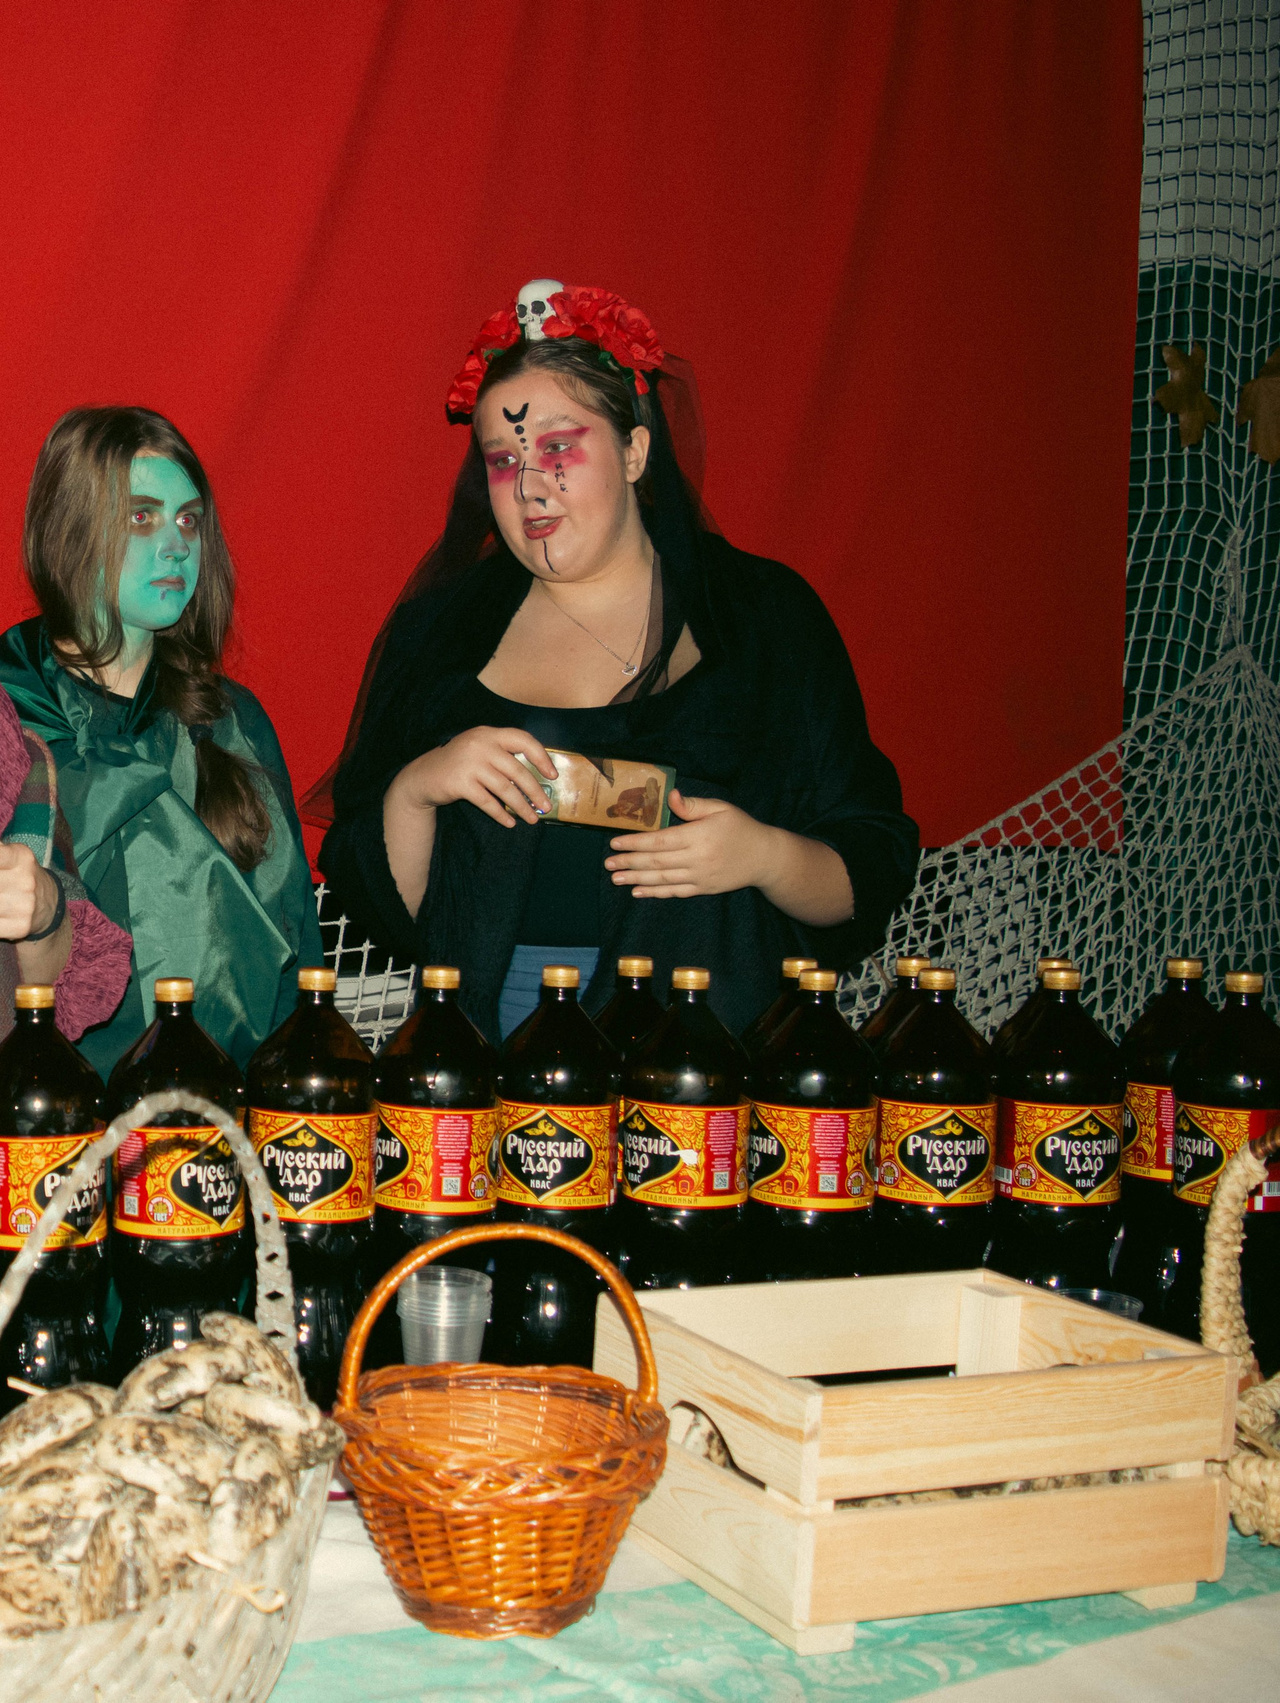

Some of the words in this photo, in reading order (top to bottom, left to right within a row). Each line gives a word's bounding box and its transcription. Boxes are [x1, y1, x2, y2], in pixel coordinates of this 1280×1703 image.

[263, 1144, 346, 1176] Русский
[506, 1133, 585, 1164] Русский
[907, 1134, 987, 1164] Русский
[1045, 1134, 1119, 1164] Русский
[181, 1160, 241, 1193] Русски
[521, 1156, 562, 1180] Дар
[926, 1156, 967, 1178] Дар
[1065, 1156, 1104, 1178] Дар
[202, 1180, 236, 1204] Дар
[279, 1168, 322, 1193] Дар
[530, 1179, 551, 1190] КВАС
[936, 1178, 959, 1188] КВАС
[1075, 1178, 1096, 1188] КВАС
[288, 1192, 311, 1203] КВАС
[212, 1204, 231, 1217] КВАС
